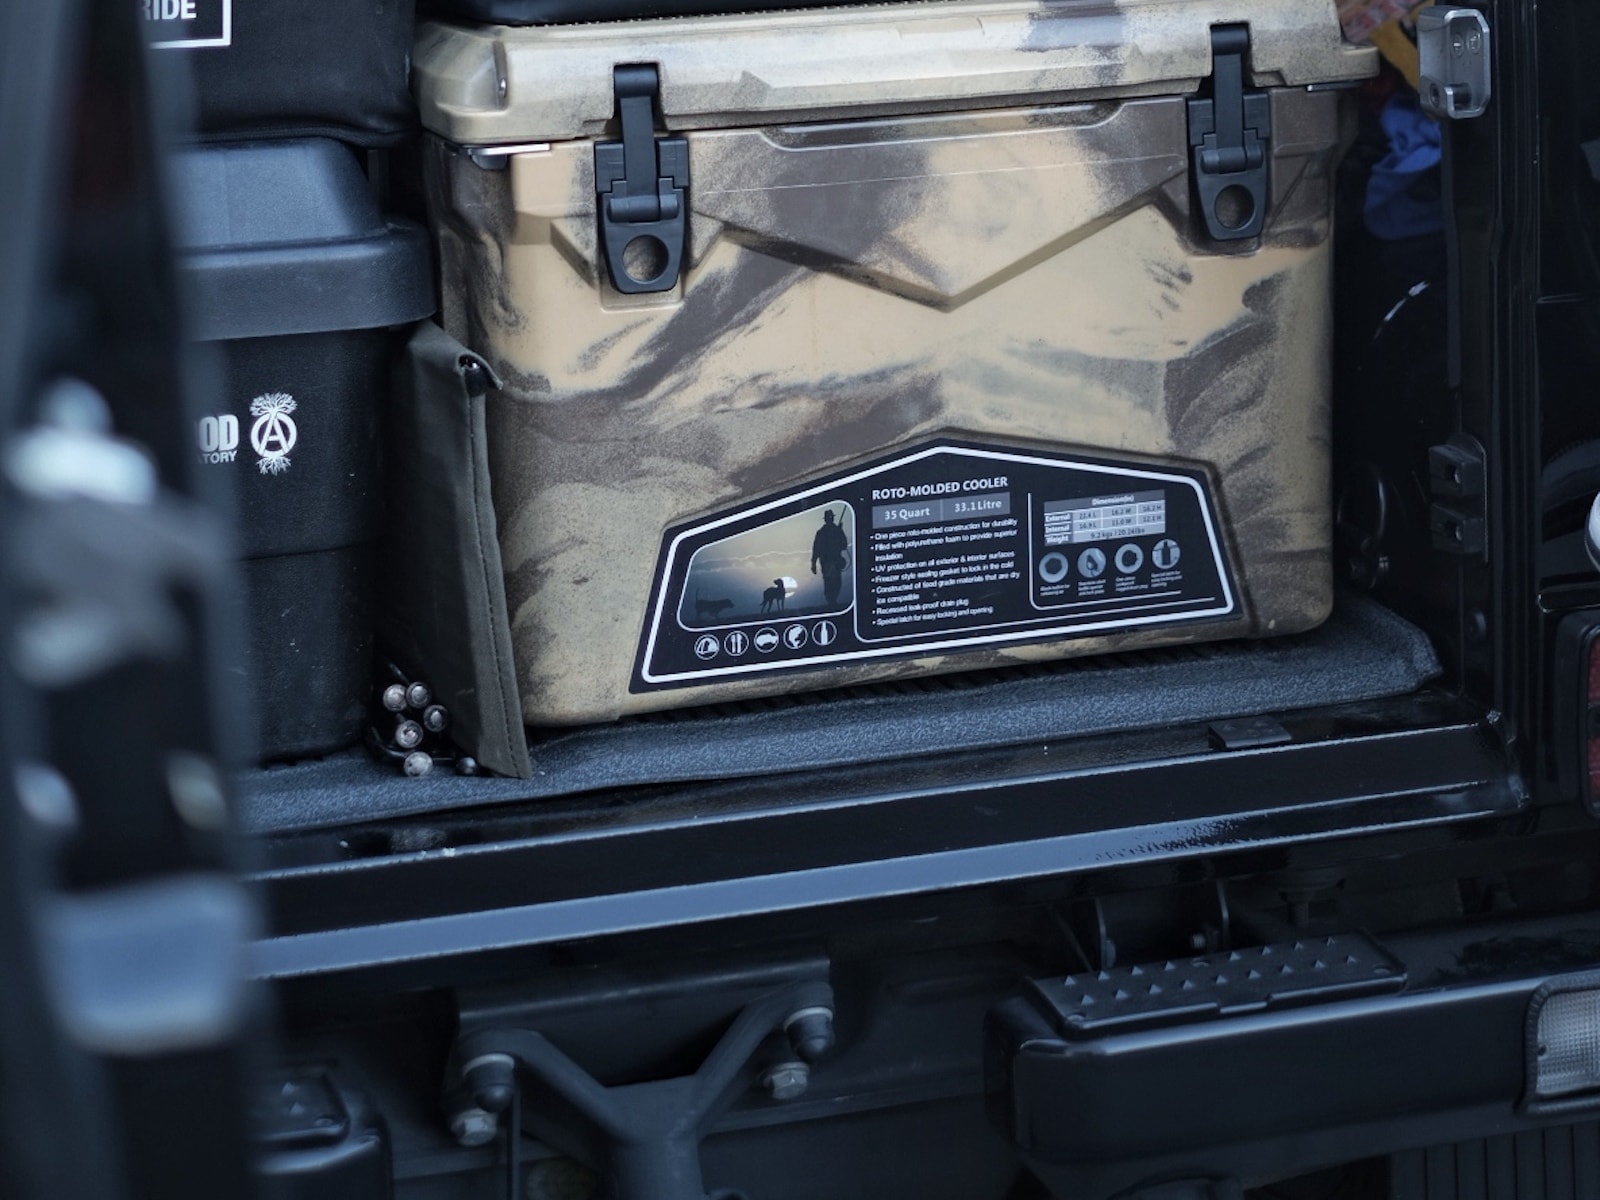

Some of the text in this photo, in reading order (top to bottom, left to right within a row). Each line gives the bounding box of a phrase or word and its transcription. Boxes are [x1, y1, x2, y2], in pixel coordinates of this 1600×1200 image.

[872, 476, 1008, 500] ROTO-MOLDED COOLER
[954, 499, 1002, 513] 33.1 Litre
[884, 507, 930, 521] 35 Quart
[875, 564, 886, 572] UV
[887, 562, 918, 572] protection
[989, 551, 1016, 559] surfaces
[875, 575, 900, 583] Freezer
[900, 572, 916, 581] style
[876, 583, 913, 594] Constructed
[956, 575, 984, 584] materials
[1010, 571, 1020, 579] dry
[958, 608, 969, 616] and
